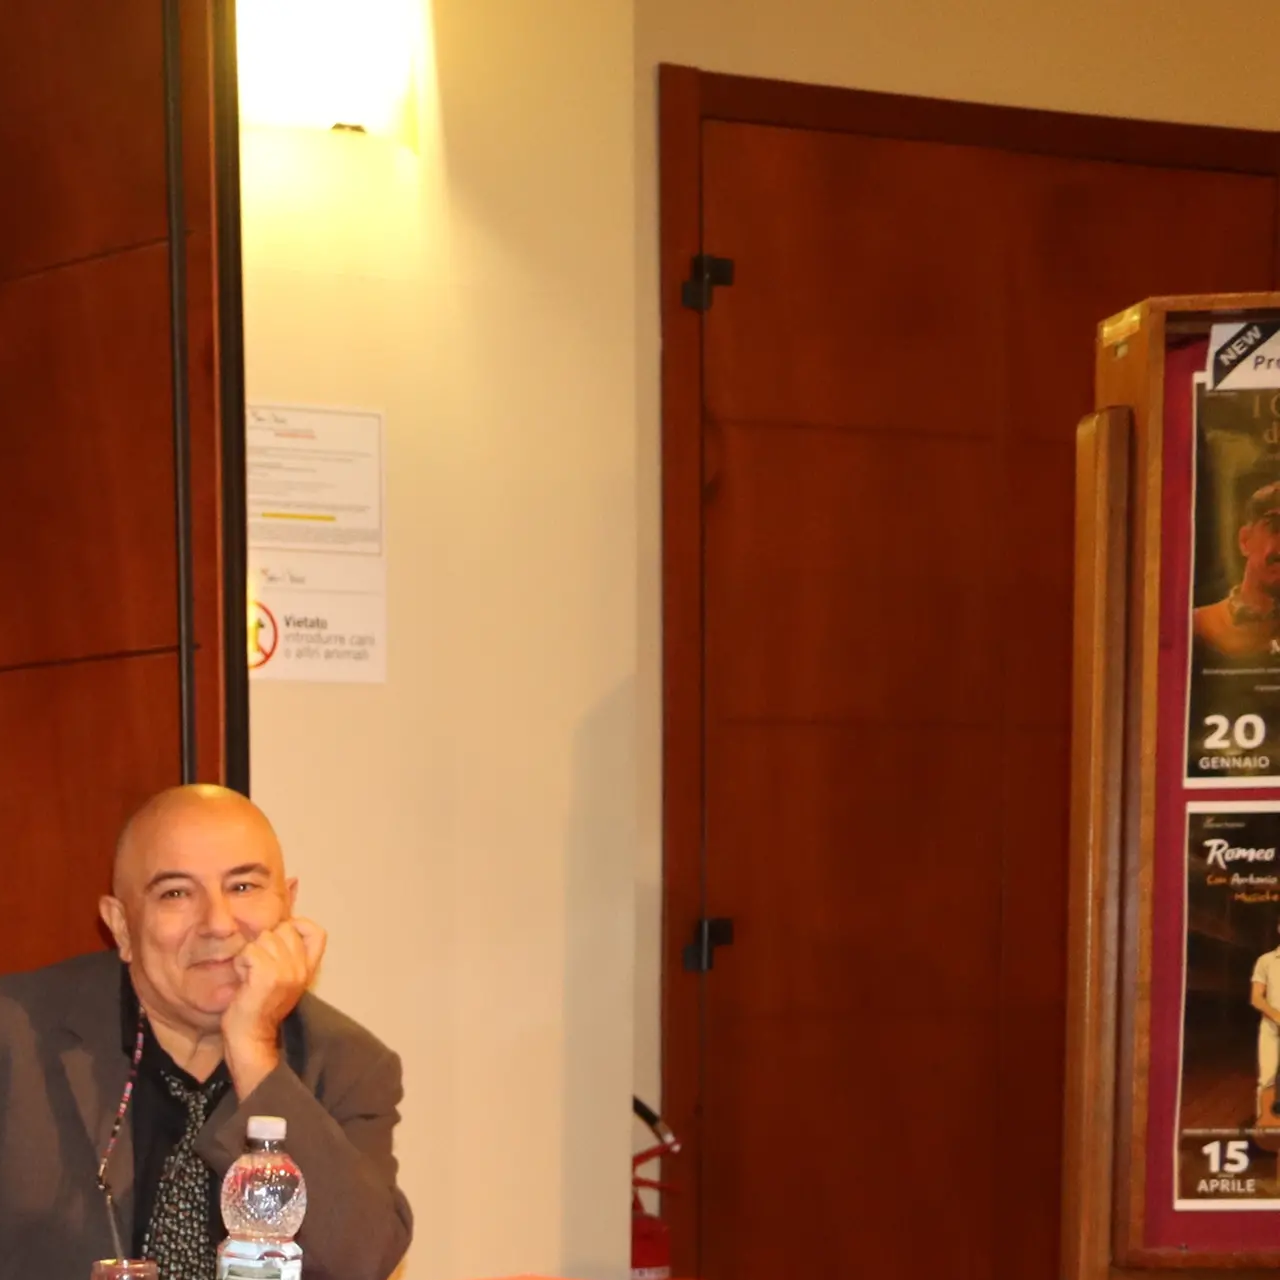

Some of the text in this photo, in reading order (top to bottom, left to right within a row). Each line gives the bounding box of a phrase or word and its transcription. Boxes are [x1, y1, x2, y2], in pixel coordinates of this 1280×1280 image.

[1220, 325, 1261, 366] NEW
[284, 614, 328, 629] Vietato
[1203, 713, 1266, 750] 20
[1198, 755, 1271, 770] GENNAIO
[1202, 838, 1277, 871] Romeo
[1202, 1140, 1250, 1173] 15
[1196, 1178, 1257, 1193] APRILE
